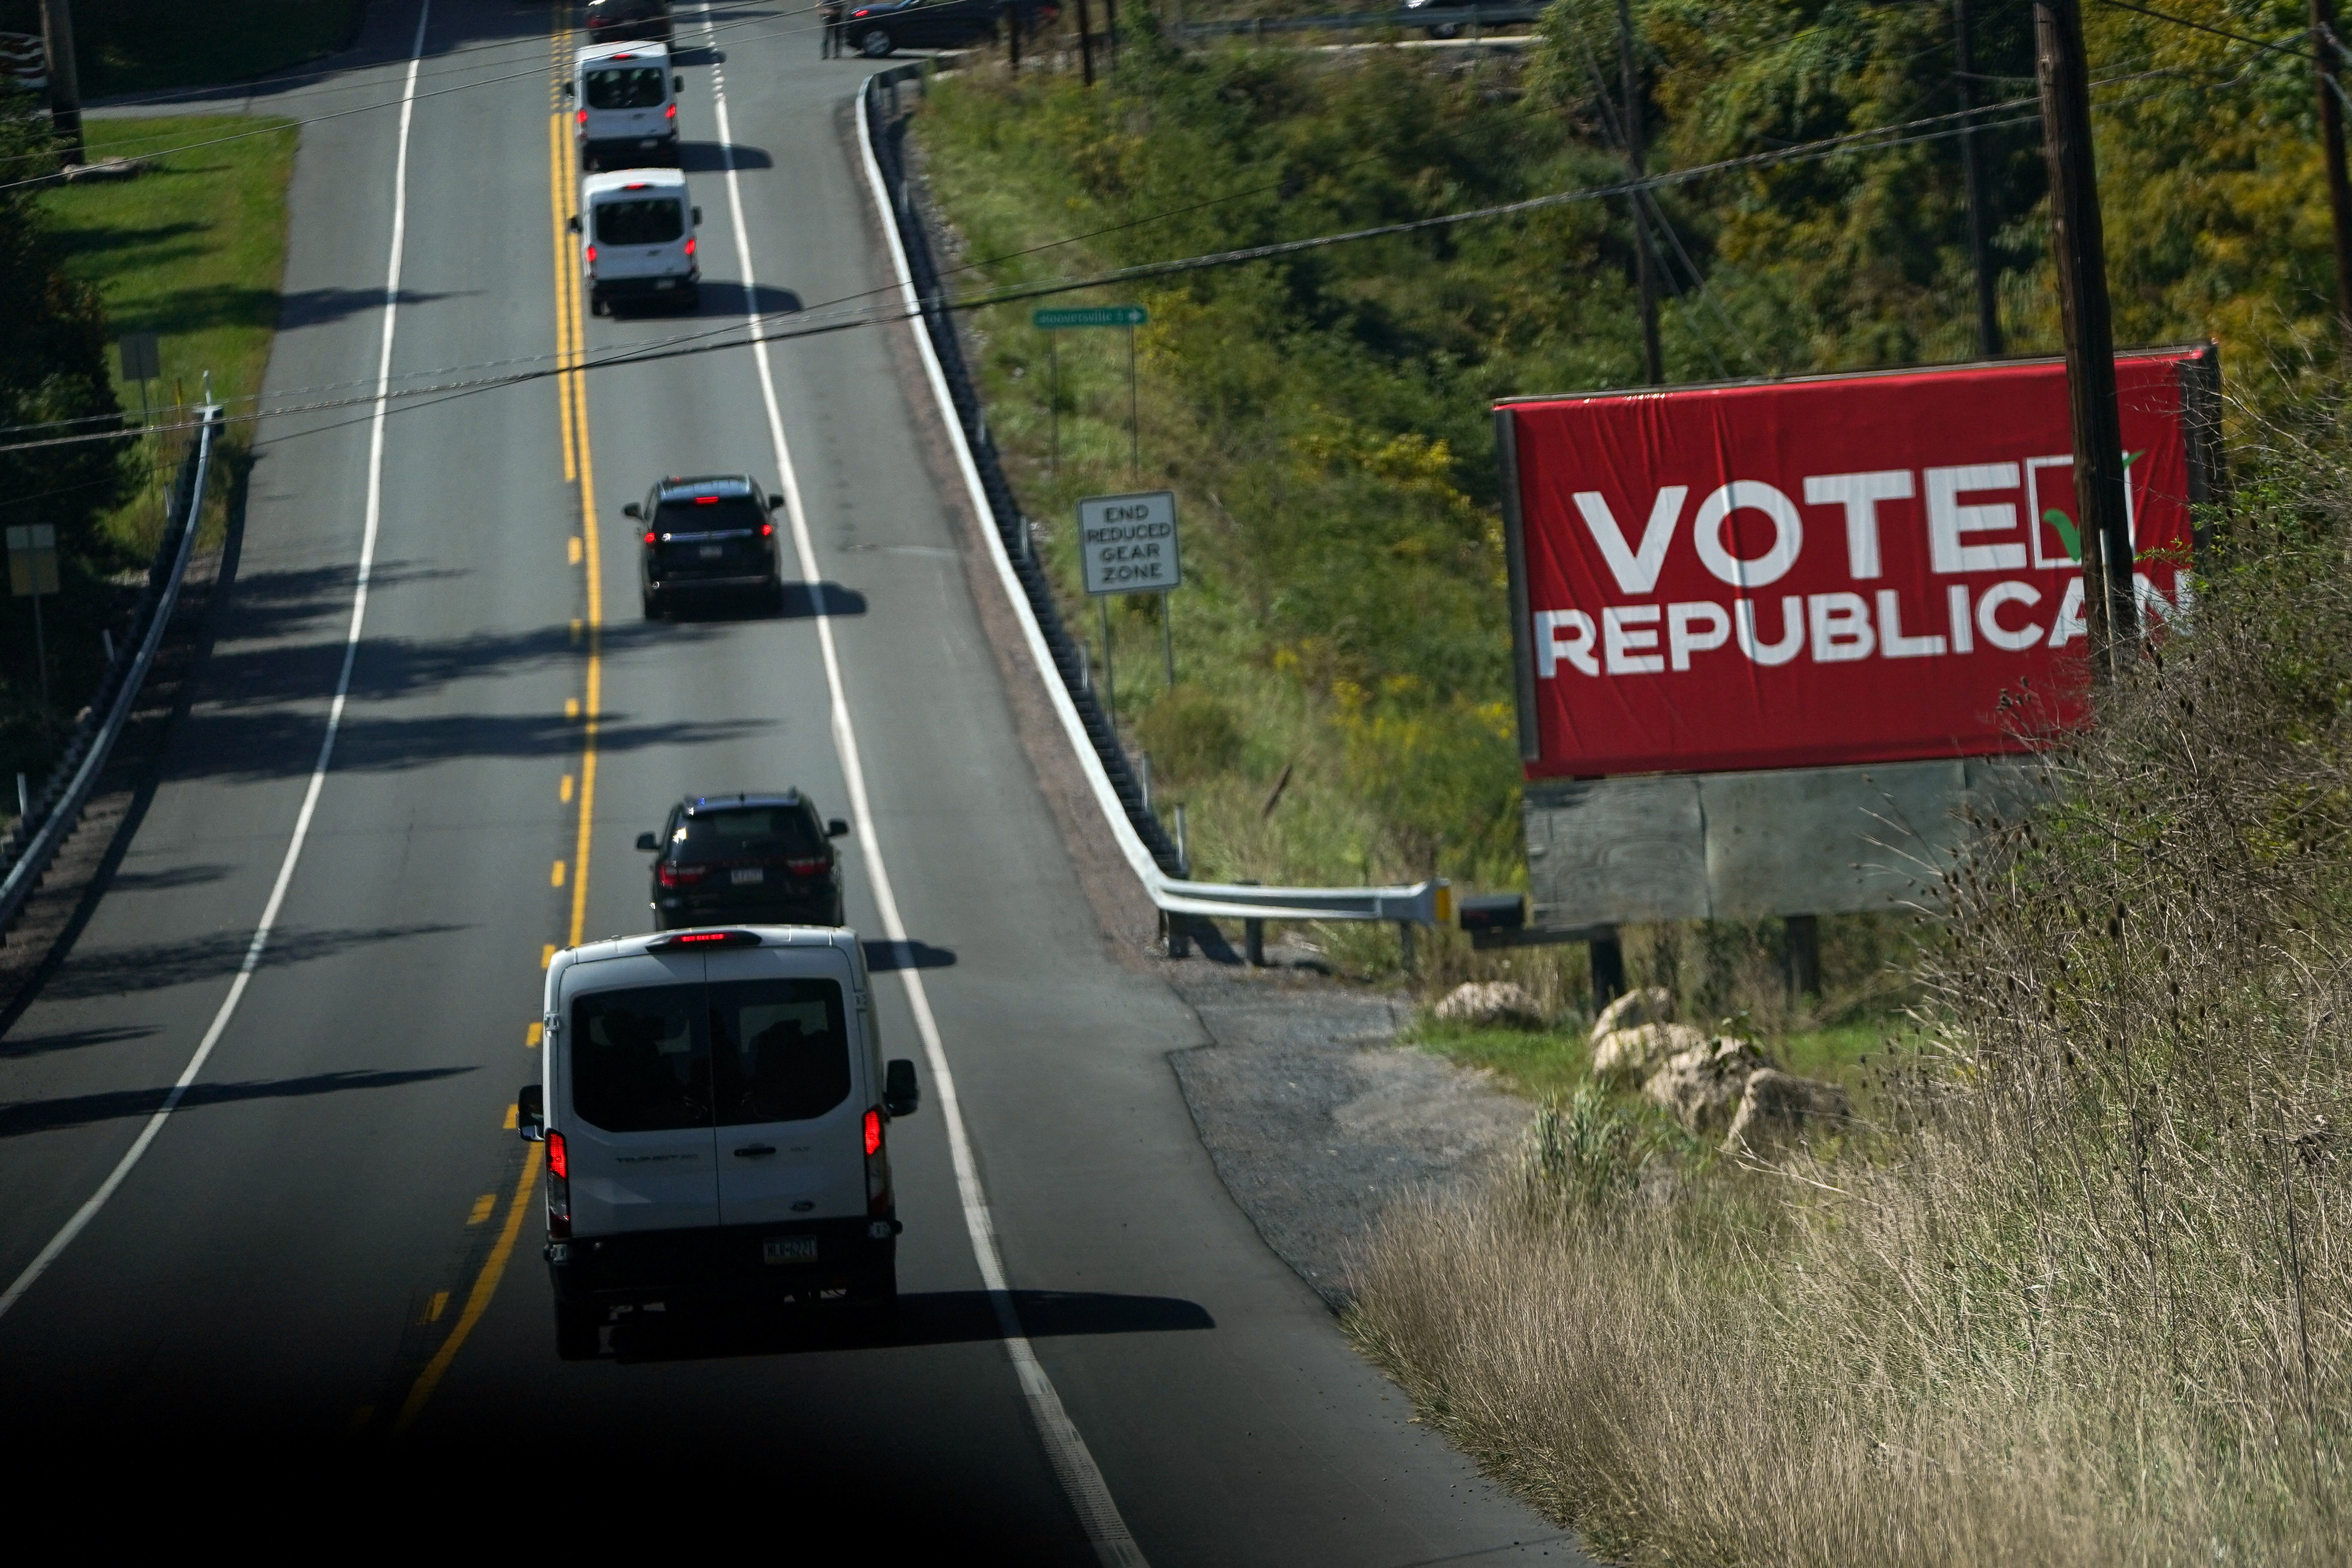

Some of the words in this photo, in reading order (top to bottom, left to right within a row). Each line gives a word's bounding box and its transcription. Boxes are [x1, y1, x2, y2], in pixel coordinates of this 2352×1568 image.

[1104, 504, 1149, 523] END
[1087, 522, 1171, 543] REDUCED
[1572, 461, 2026, 595] VOTE
[1101, 542, 1161, 561] GEAR
[1101, 562, 1163, 584] ZONE
